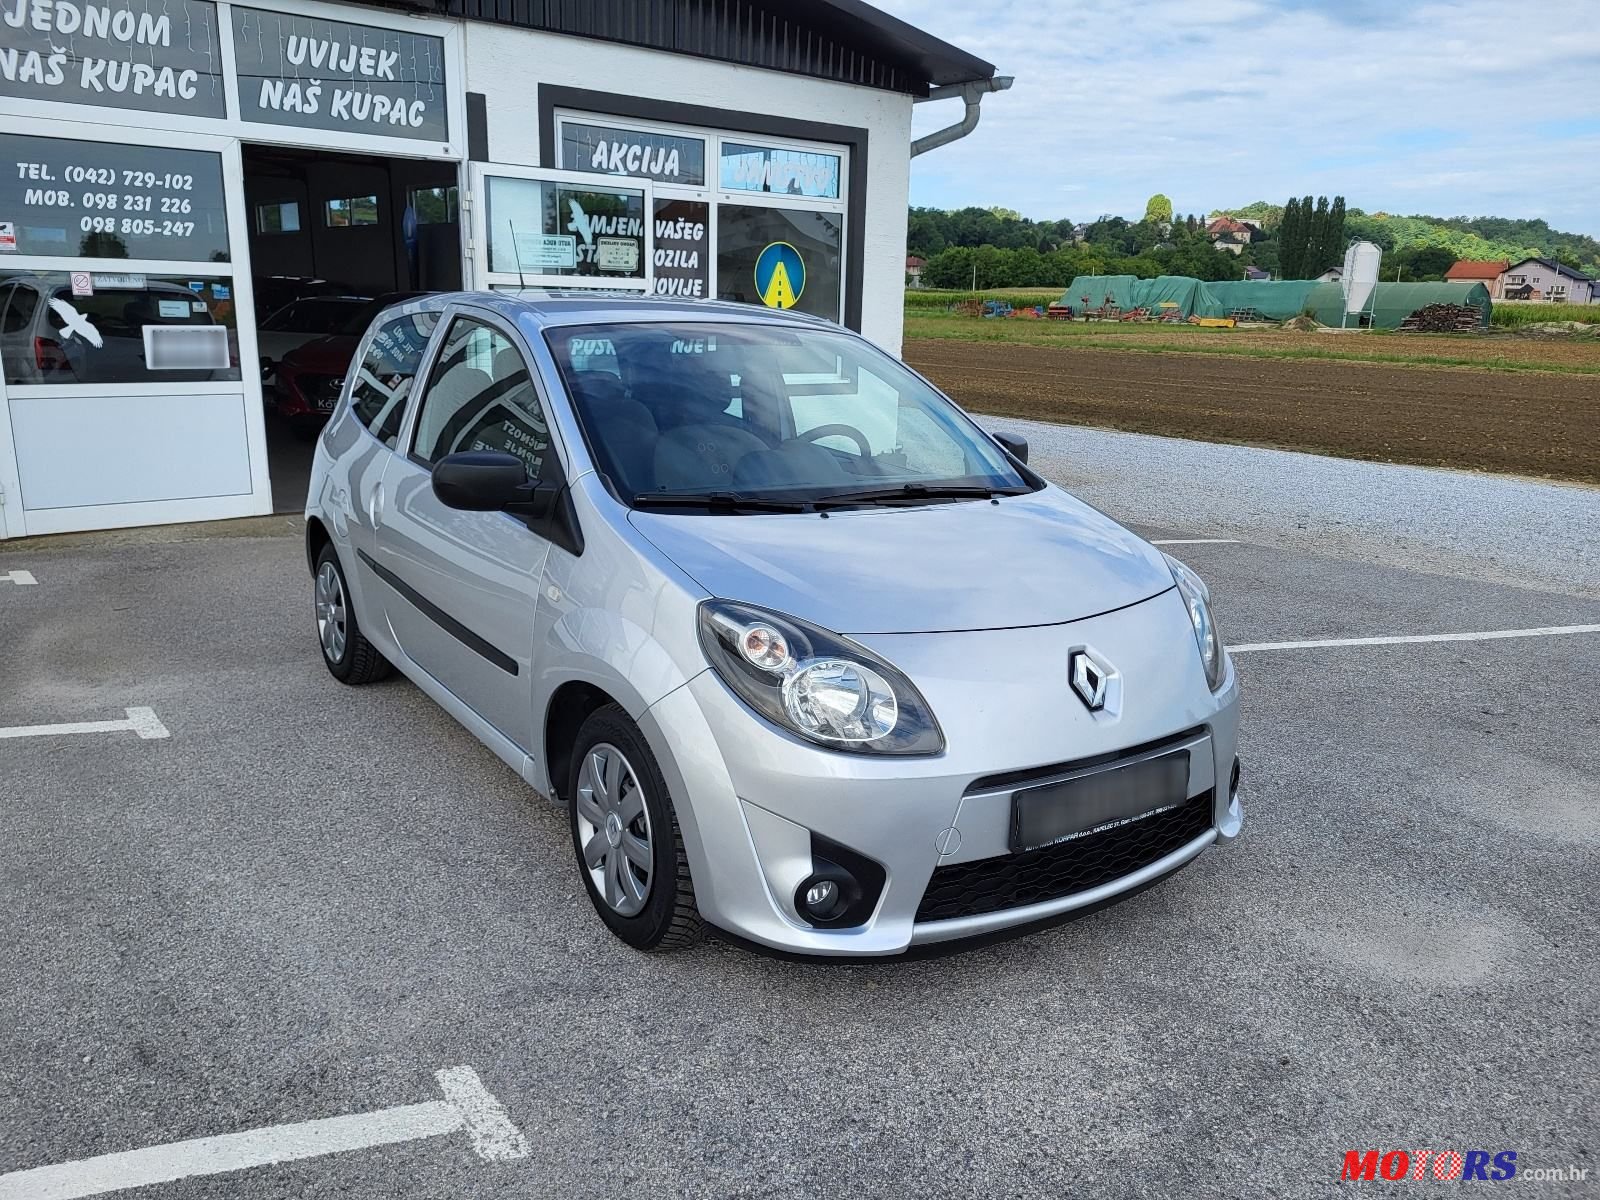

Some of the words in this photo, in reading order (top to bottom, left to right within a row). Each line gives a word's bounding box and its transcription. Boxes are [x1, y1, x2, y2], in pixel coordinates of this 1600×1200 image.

[4, 0, 170, 47] JEDNOM
[0, 45, 67, 86] NAŠ
[80, 57, 198, 100] KUPAC
[286, 35, 398, 81] UVIJEK
[259, 78, 322, 114] NAŠ
[330, 89, 426, 128] KUPAC
[591, 140, 681, 177] AKCIJA
[16, 162, 56, 181] TEL.
[64, 165, 116, 186] (042)
[122, 170, 193, 190] 729-102
[24, 188, 75, 208] MOB.
[82, 193, 118, 210] 098
[123, 195, 152, 212] 231
[160, 197, 192, 214] 226
[80, 216, 115, 233] 098
[120, 218, 195, 237] 805-247
[655, 217, 704, 241] VAŠEG
[653, 249, 699, 269] OZILA
